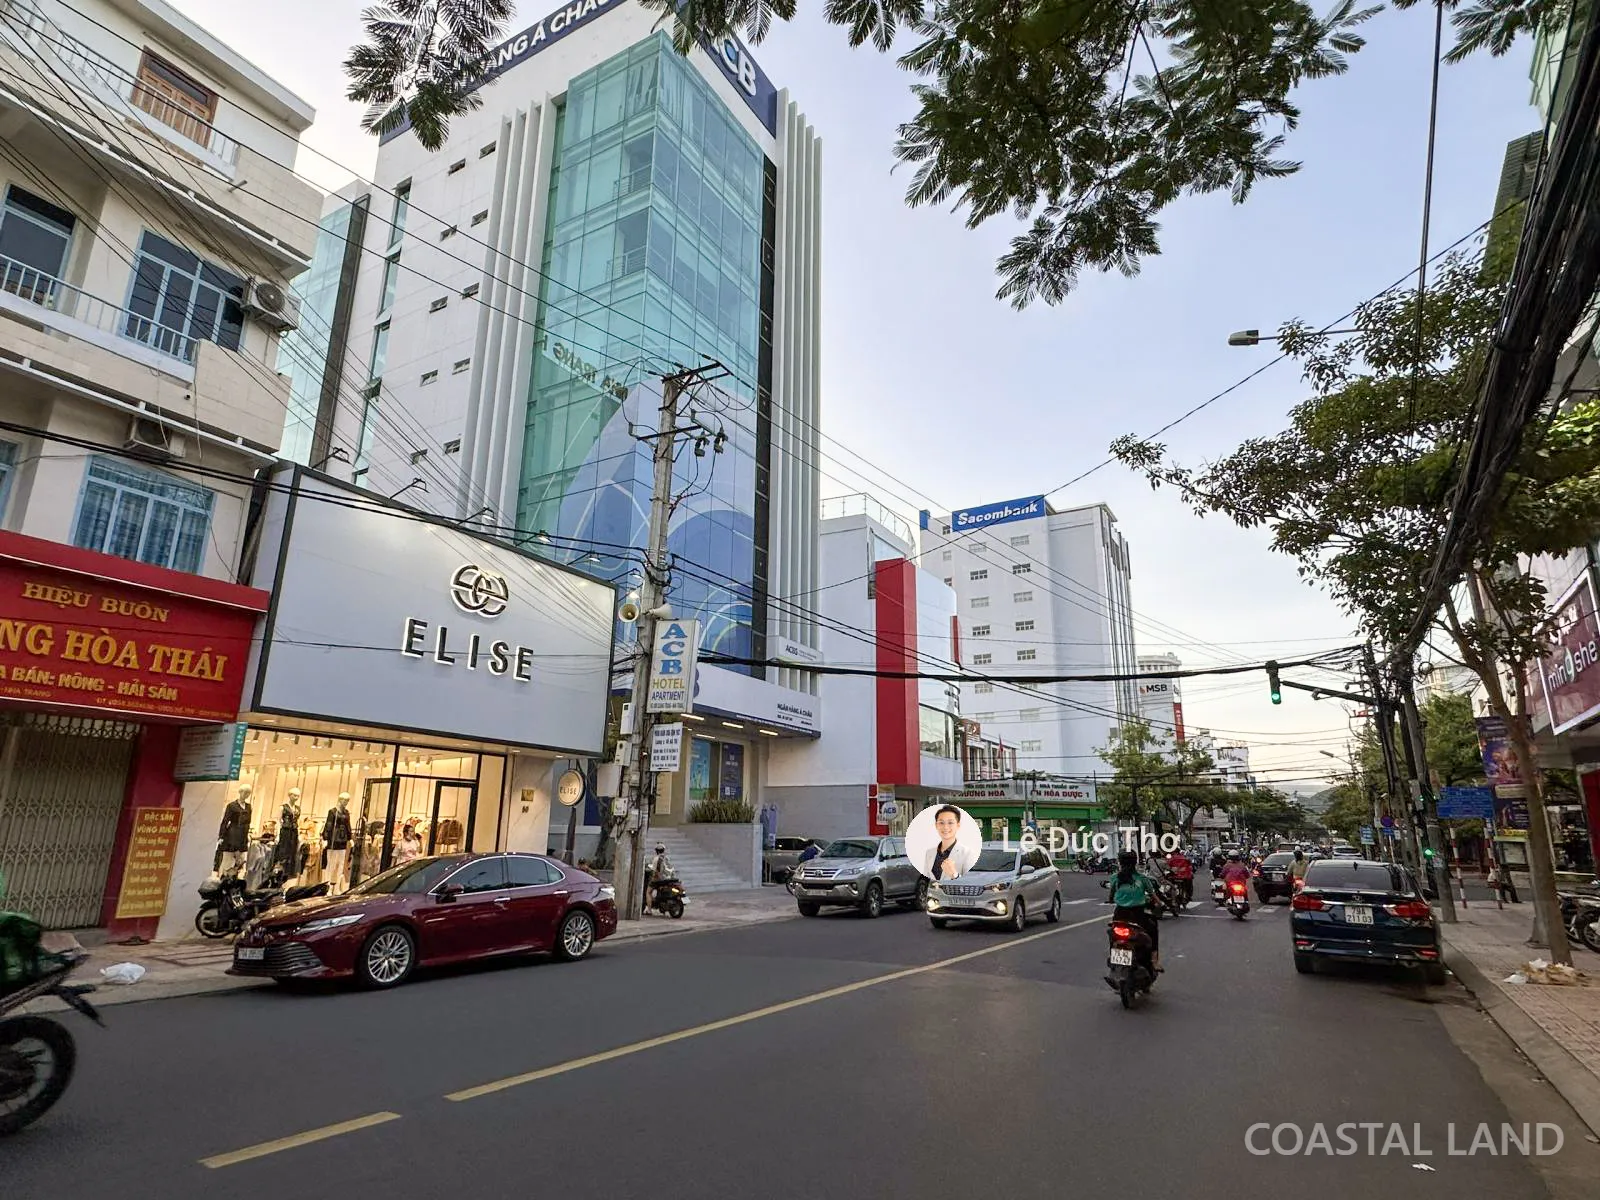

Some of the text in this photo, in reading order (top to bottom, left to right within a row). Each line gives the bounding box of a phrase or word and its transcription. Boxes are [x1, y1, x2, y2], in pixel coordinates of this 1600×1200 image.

[957, 503, 1038, 526] Sacombank
[21, 581, 169, 622] HIỆU BUÔN
[61, 628, 140, 670] HÒA
[148, 644, 228, 682] THÁI
[402, 617, 534, 682] ELISE
[659, 622, 688, 675] ACB
[58, 672, 105, 693] NÔNG
[117, 679, 145, 698] HẢI
[148, 682, 178, 702] SẢN
[651, 690, 685, 701] APARTMENT
[652, 678, 685, 689] HOTEL
[1146, 684, 1167, 693] MSB
[560, 786, 577, 795] ELISE
